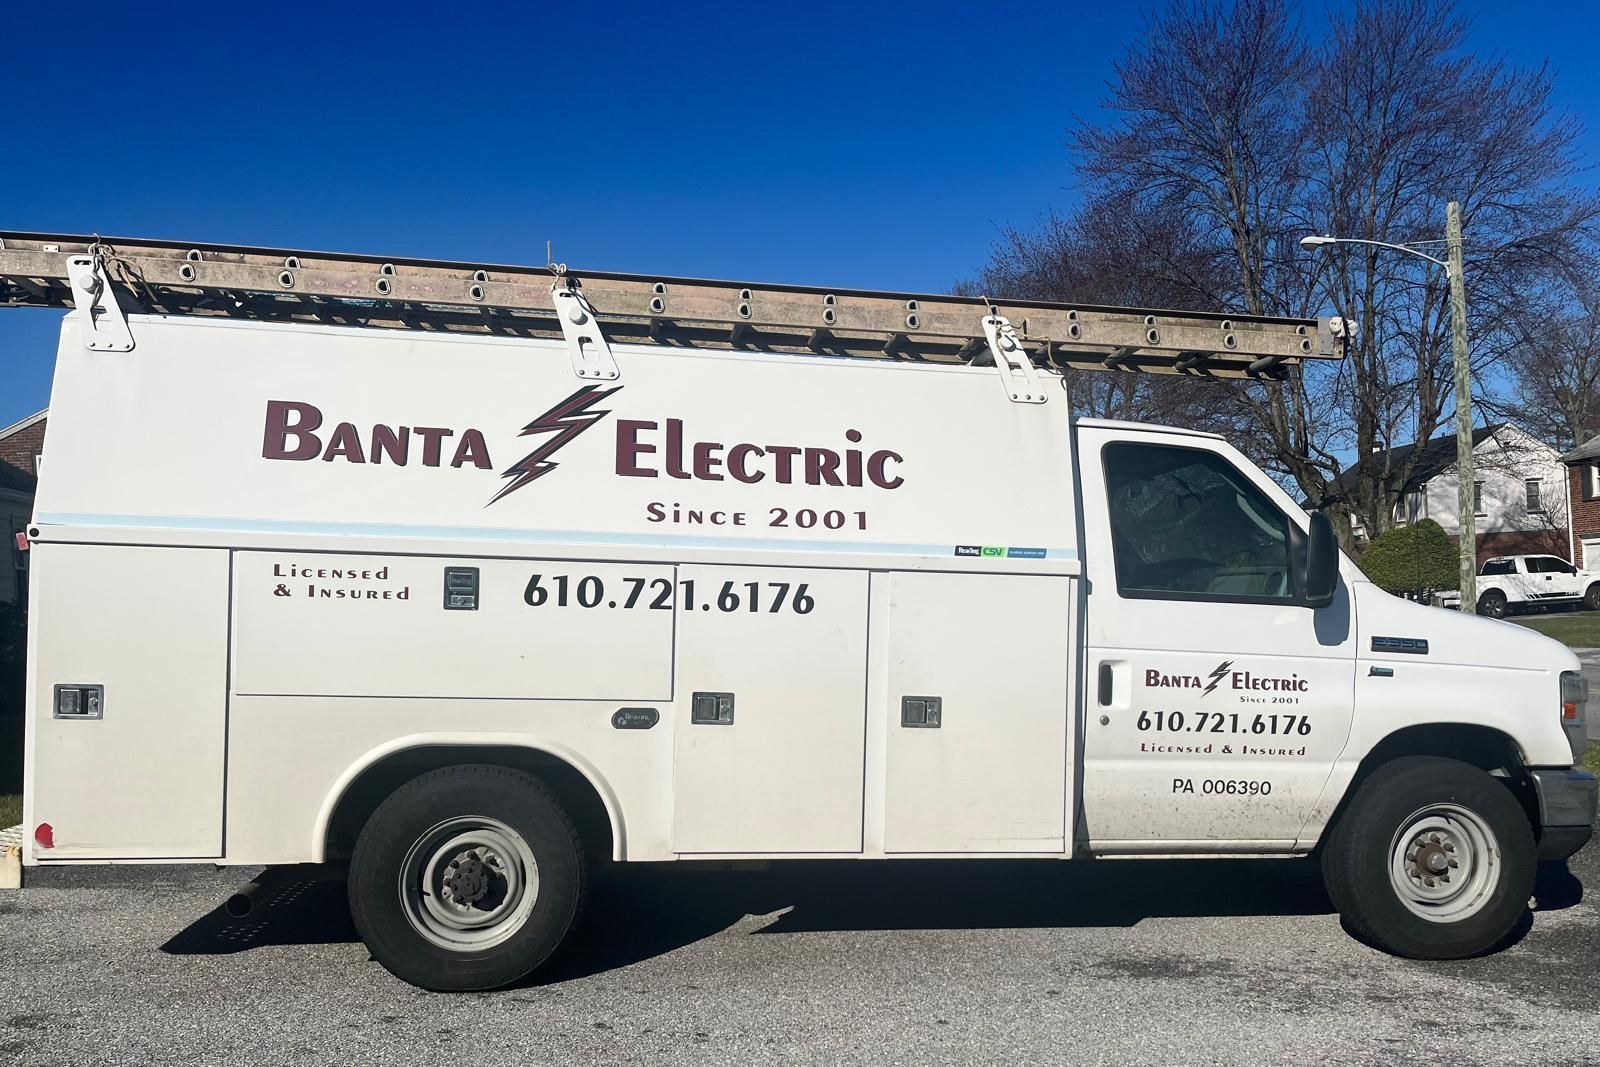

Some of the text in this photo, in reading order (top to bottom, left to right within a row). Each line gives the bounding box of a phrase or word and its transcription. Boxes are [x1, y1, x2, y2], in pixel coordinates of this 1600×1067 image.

[261, 399, 494, 470] BANTA
[768, 507, 868, 531] 2001
[983, 547, 1003, 556] CSV
[273, 583, 292, 597] &
[523, 574, 815, 615] 610.721.6176
[1145, 669, 1202, 689] BANTA
[1271, 696, 1299, 705] 2001
[1136, 710, 1312, 736] 610.721.6176
[1221, 744, 1233, 754] &
[1172, 778, 1272, 796] PA 006390
